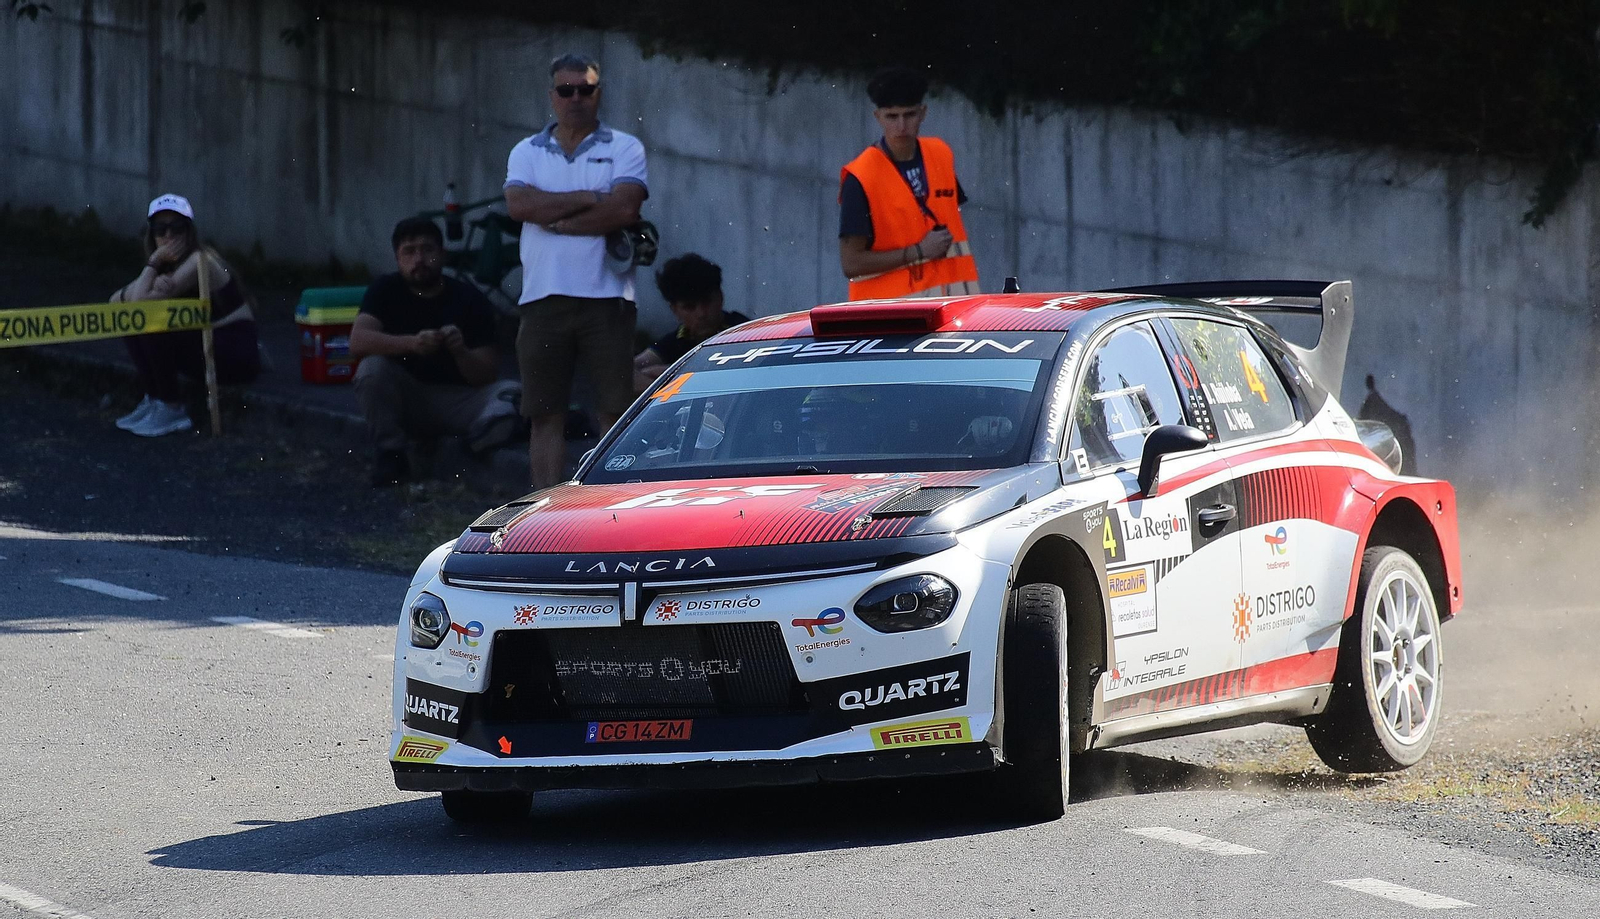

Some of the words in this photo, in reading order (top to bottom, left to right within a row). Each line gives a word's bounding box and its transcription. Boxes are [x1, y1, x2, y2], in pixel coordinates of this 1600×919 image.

[0, 316, 55, 341] ZONA
[60, 309, 146, 335] PUBLICO
[708, 338, 1034, 365] YPSILON
[1240, 350, 1269, 404] 4
[651, 372, 694, 402] 4
[607, 456, 632, 470] FIA
[1083, 506, 1103, 521] SPORTS
[1103, 516, 1117, 557] 4
[1123, 520, 1142, 541] La
[564, 556, 716, 573] LANCIA
[1266, 561, 1290, 570] TotalEnergies
[1116, 574, 1139, 593] Recalvi
[543, 605, 614, 615] DISTRIGO
[686, 598, 761, 610] DISTRIGO
[1256, 585, 1316, 618] DISTRIGO
[1256, 623, 1272, 633] PARTS
[1272, 615, 1306, 629] DISTRIBUTION
[449, 648, 481, 661] TotalEnergies
[795, 637, 851, 653] TotalEnergies
[1144, 647, 1189, 665] YPSILON
[1124, 664, 1186, 687] INTEGRALE
[838, 670, 960, 710] QUARTZ
[601, 724, 627, 740] CG
[633, 722, 652, 739] 14
[654, 721, 685, 738] ZM
[880, 722, 962, 745] PIRELLI
[398, 741, 444, 759] PIRELLI
